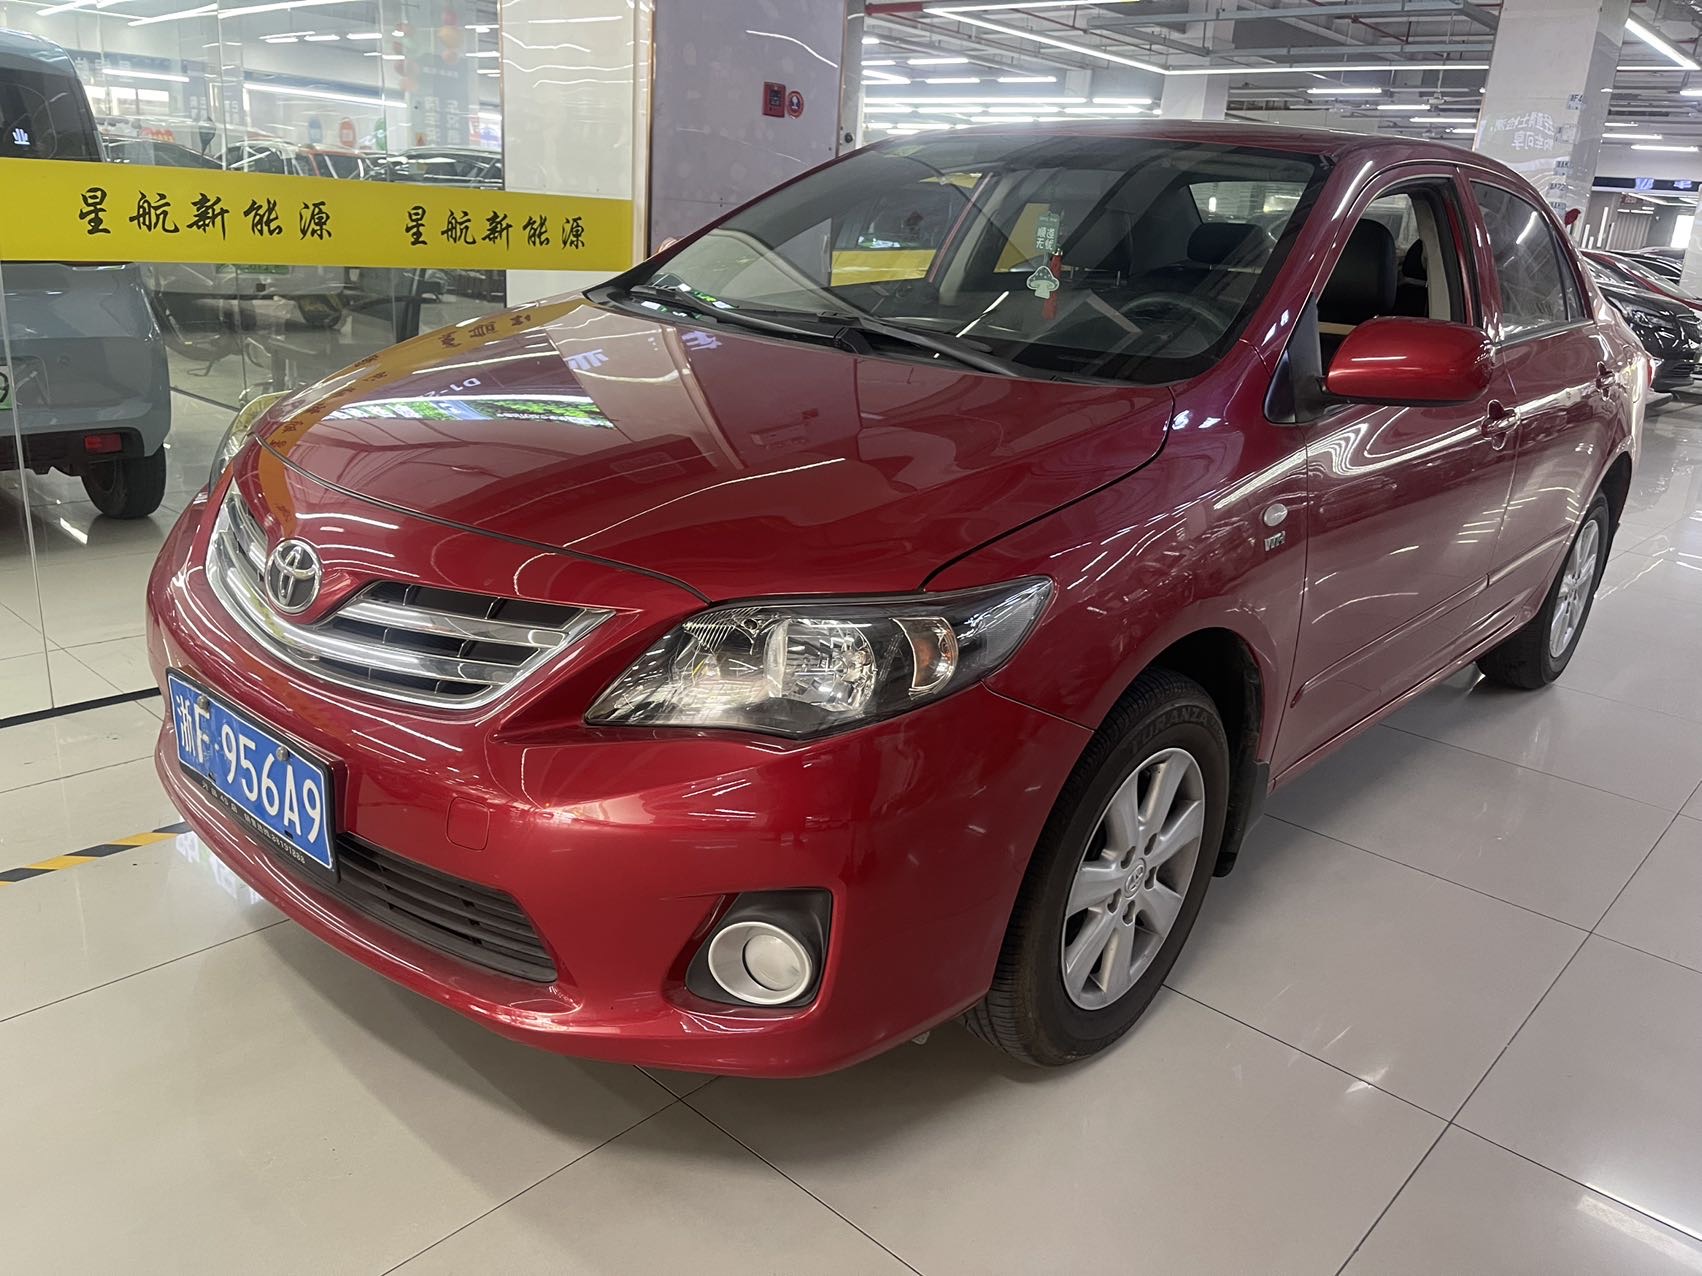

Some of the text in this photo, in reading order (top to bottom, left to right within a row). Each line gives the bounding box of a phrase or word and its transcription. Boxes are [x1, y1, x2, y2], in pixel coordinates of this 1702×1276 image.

[78, 187, 333, 241] 星航新能源
[404, 204, 587, 251] 星航新能源
